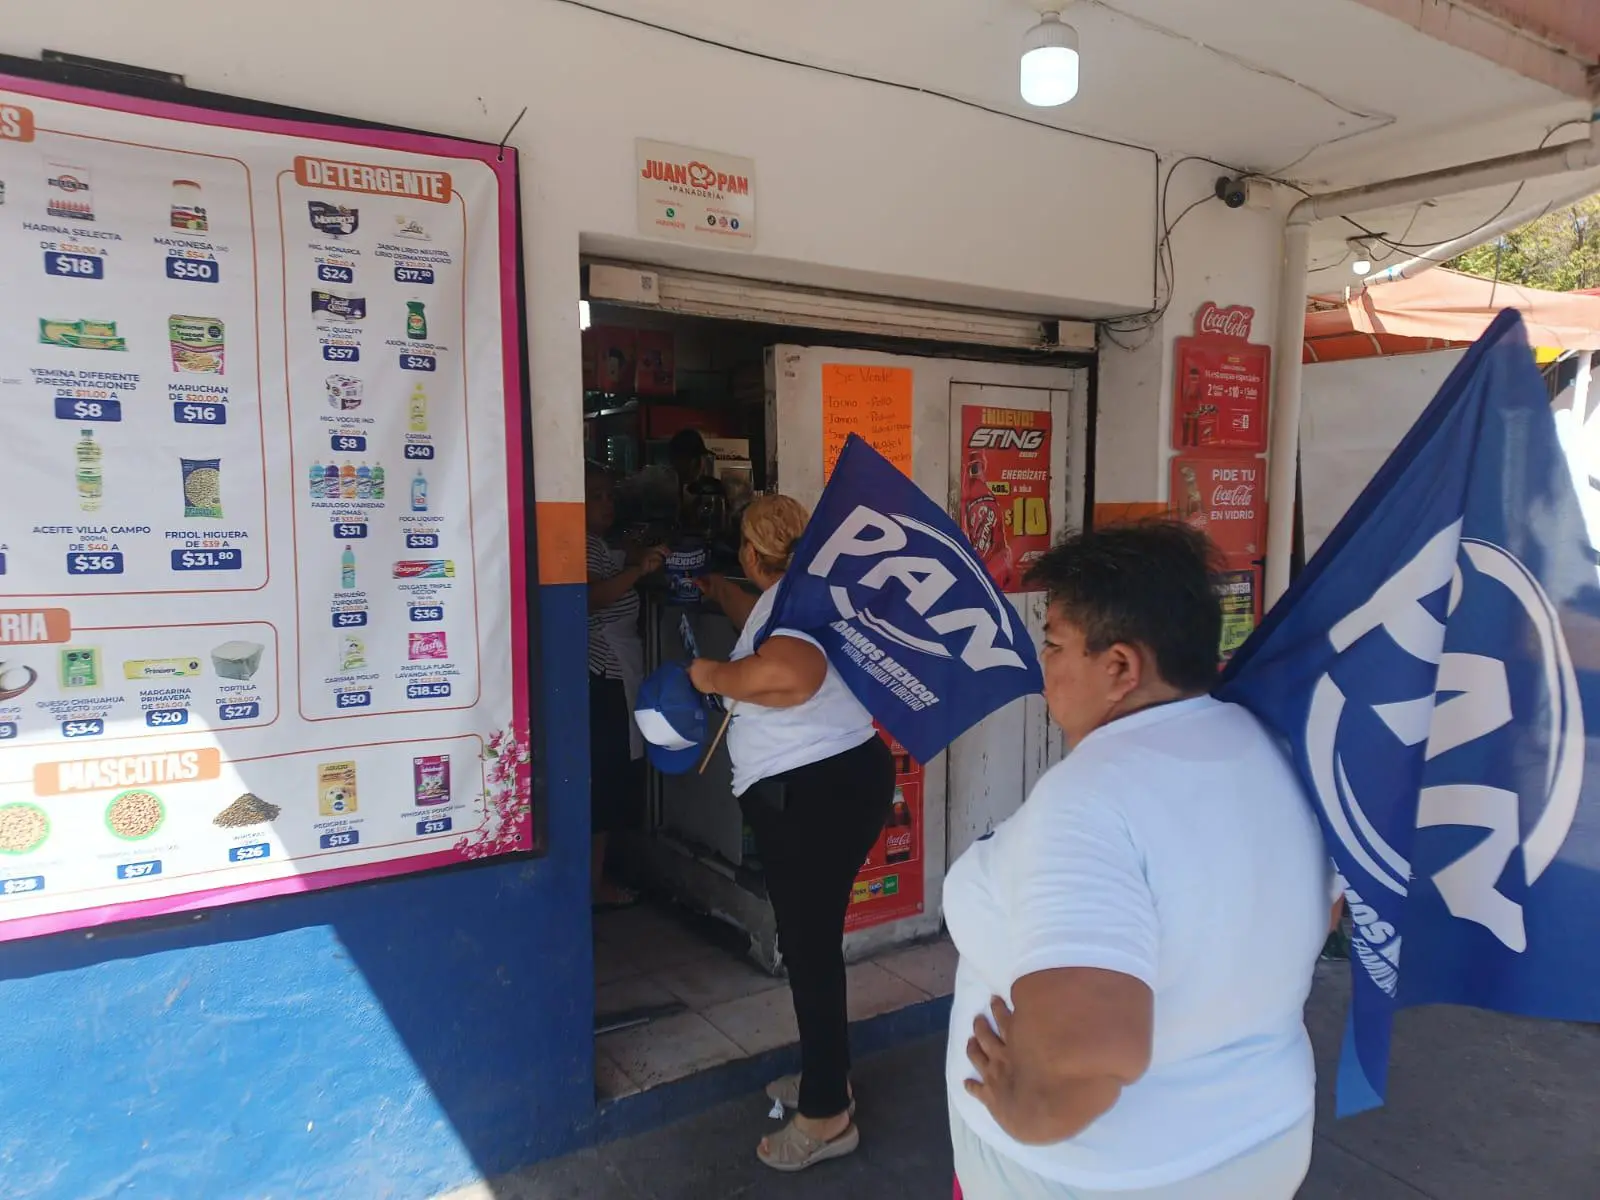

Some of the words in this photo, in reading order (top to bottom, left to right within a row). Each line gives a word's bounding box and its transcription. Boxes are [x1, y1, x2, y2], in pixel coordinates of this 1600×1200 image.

[305, 159, 444, 199] DETERGENTE
[641, 159, 687, 185] JUAN
[717, 172, 748, 195] PAN
[23, 222, 71, 235] HARINA
[72, 228, 122, 241] SELECTA
[40, 241, 56, 251] DE
[100, 248, 108, 256] A
[154, 237, 213, 250] MAYONESA
[169, 248, 184, 257] DE
[57, 256, 94, 274] $18
[173, 262, 212, 279] $50
[322, 267, 349, 281] $24
[1201, 306, 1248, 337] Coca-Cola
[328, 348, 353, 359] $57
[407, 356, 431, 368] $24
[30, 368, 76, 378] YEMINA
[79, 371, 140, 382] DIFERENTE
[36, 378, 137, 390] PRESENTACIONES
[168, 384, 228, 394] MARUCHAN
[56, 389, 72, 397] DE
[169, 393, 183, 401] DE
[74, 401, 102, 418] $8
[183, 404, 216, 422] $16
[339, 438, 357, 450] $8
[969, 428, 1044, 450] STING
[407, 446, 430, 457] $40
[1212, 469, 1238, 482] PIDE
[1241, 469, 1256, 482] TU
[1212, 485, 1255, 506] Coca-Cola
[1004, 497, 1048, 536] $10
[1210, 511, 1223, 520] EN
[1224, 510, 1254, 520] VIDRIO
[32, 526, 73, 534] ACEITE
[76, 526, 108, 534] VILLA
[111, 526, 151, 534] CAMPO
[165, 531, 201, 539] FRIJOL
[203, 531, 248, 539] HIGUERA
[339, 525, 361, 536] $31
[410, 536, 434, 547] $38
[74, 554, 115, 572] $36
[182, 550, 234, 568] $31.80
[807, 504, 1027, 672] PAN
[338, 614, 362, 626] $23
[413, 608, 439, 620] $36
[139, 688, 192, 697] MARGARINA
[219, 684, 257, 693] TORTILLA
[407, 685, 450, 697] $18.50
[862, 660, 894, 686] FAMILIA
[890, 683, 926, 712] LIBERTAD
[36, 700, 69, 709] QUESO
[71, 696, 125, 706] CHIHUAHUA
[141, 694, 191, 703] PRIMAVERA
[341, 694, 366, 706] $50
[50, 705, 90, 714] SELECTO
[225, 706, 253, 719] $27
[152, 711, 182, 726] $20
[66, 722, 100, 737] $34
[58, 751, 198, 791] MASCOTAS
[425, 821, 445, 833] $13
[329, 835, 350, 847] $13
